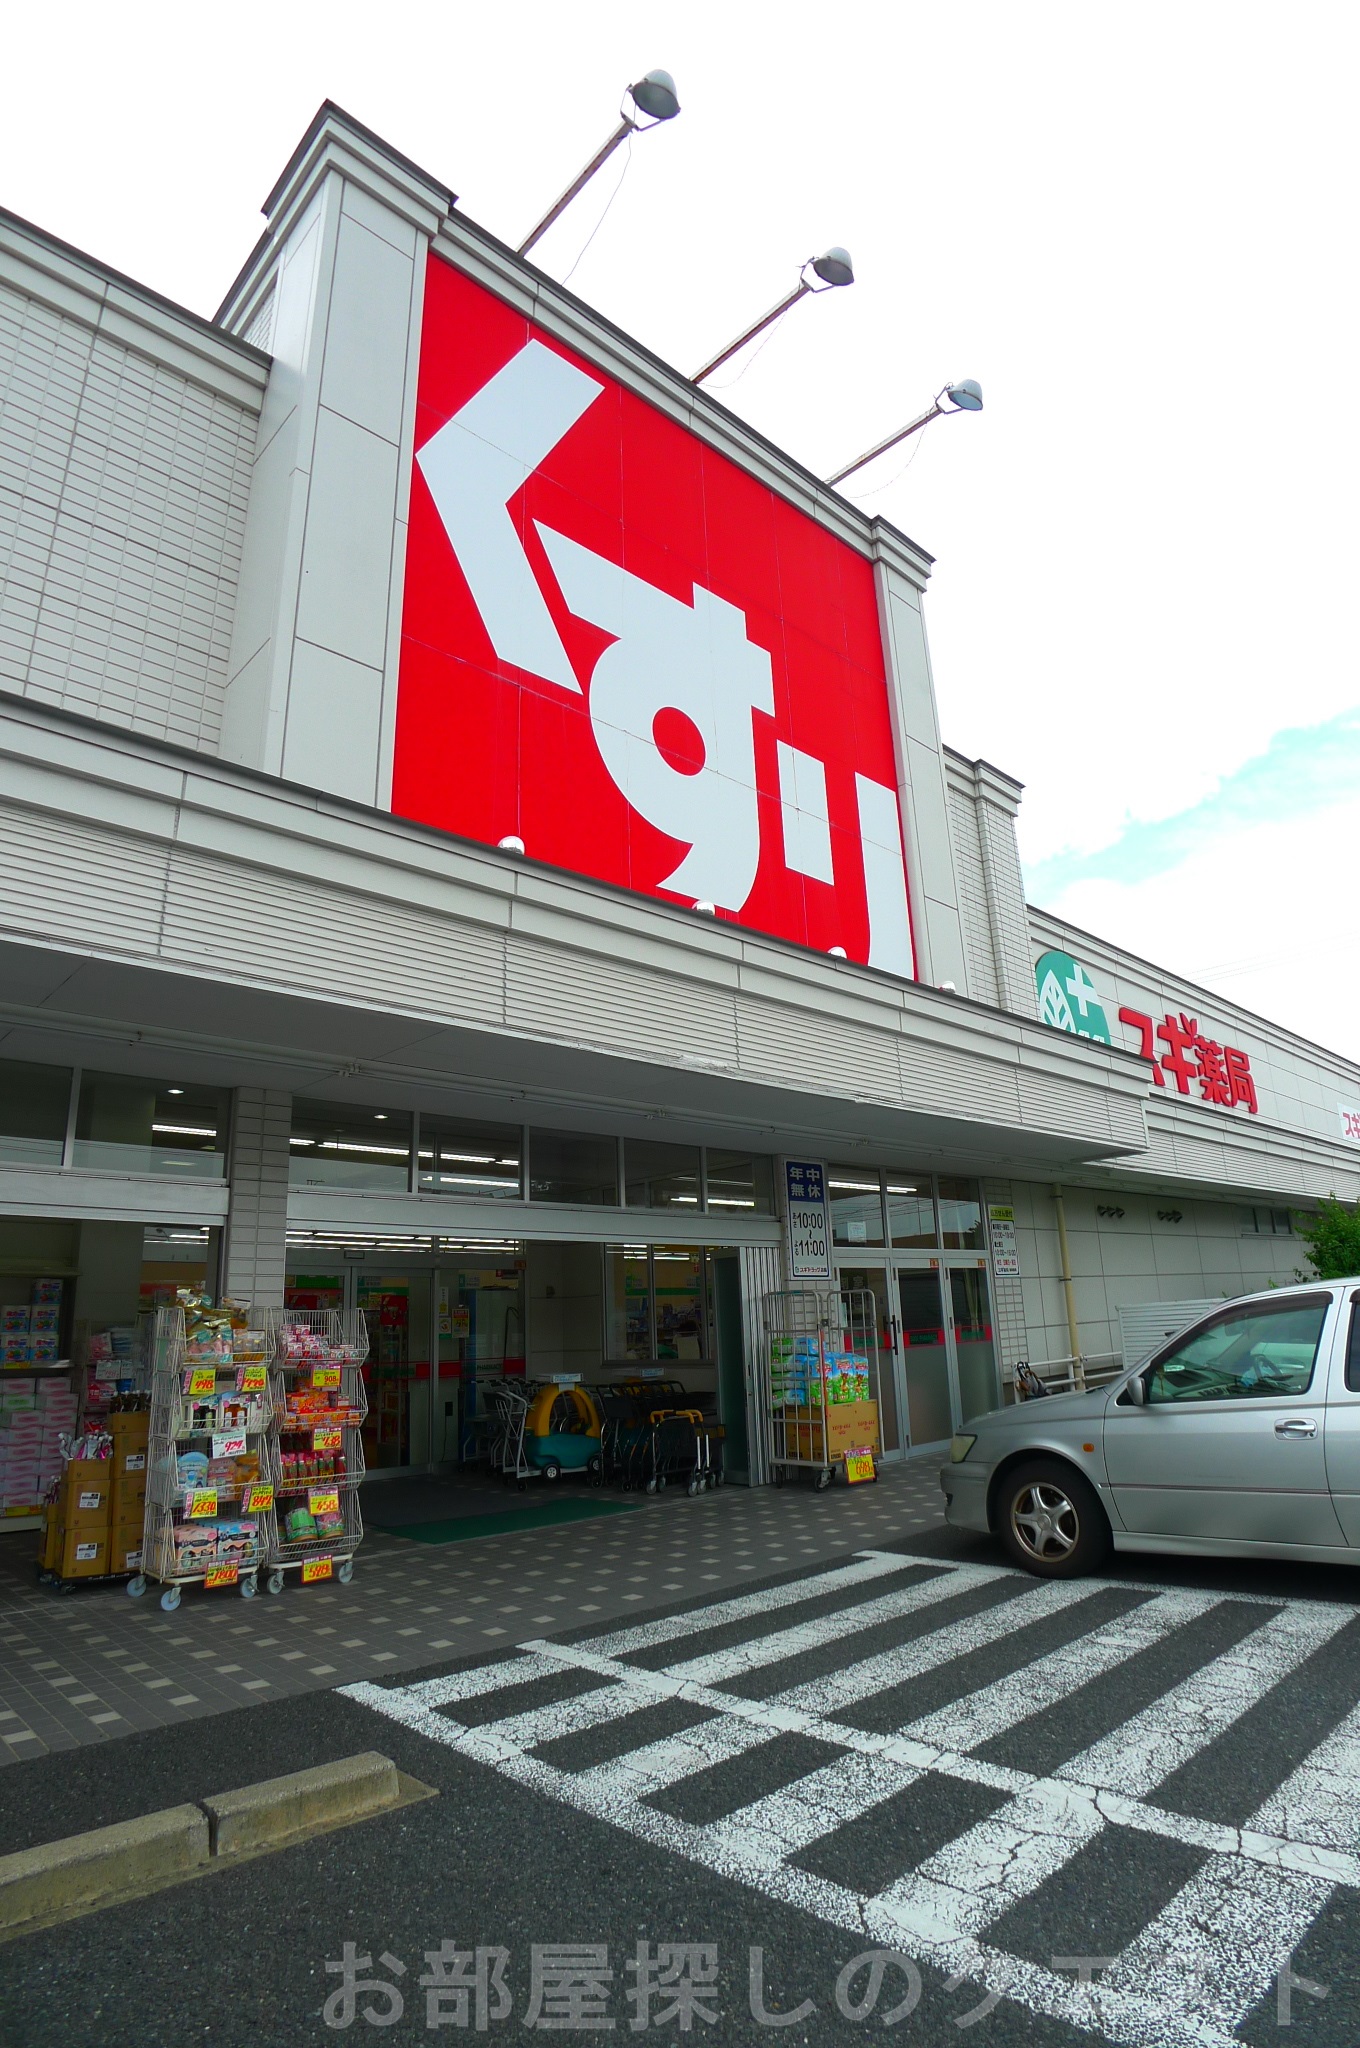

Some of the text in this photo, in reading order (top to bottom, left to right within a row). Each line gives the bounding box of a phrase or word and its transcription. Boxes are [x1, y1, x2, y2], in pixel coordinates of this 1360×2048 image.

[414, 338, 916, 981] くすり
[1118, 1007, 1258, 1114] スギ薬局
[789, 1166, 820, 1182] 年中
[791, 1182, 821, 1199] 無休
[797, 1212, 823, 1229] 10:00
[799, 1239, 825, 1256] 11:00
[855, 1461, 871, 1475] 698
